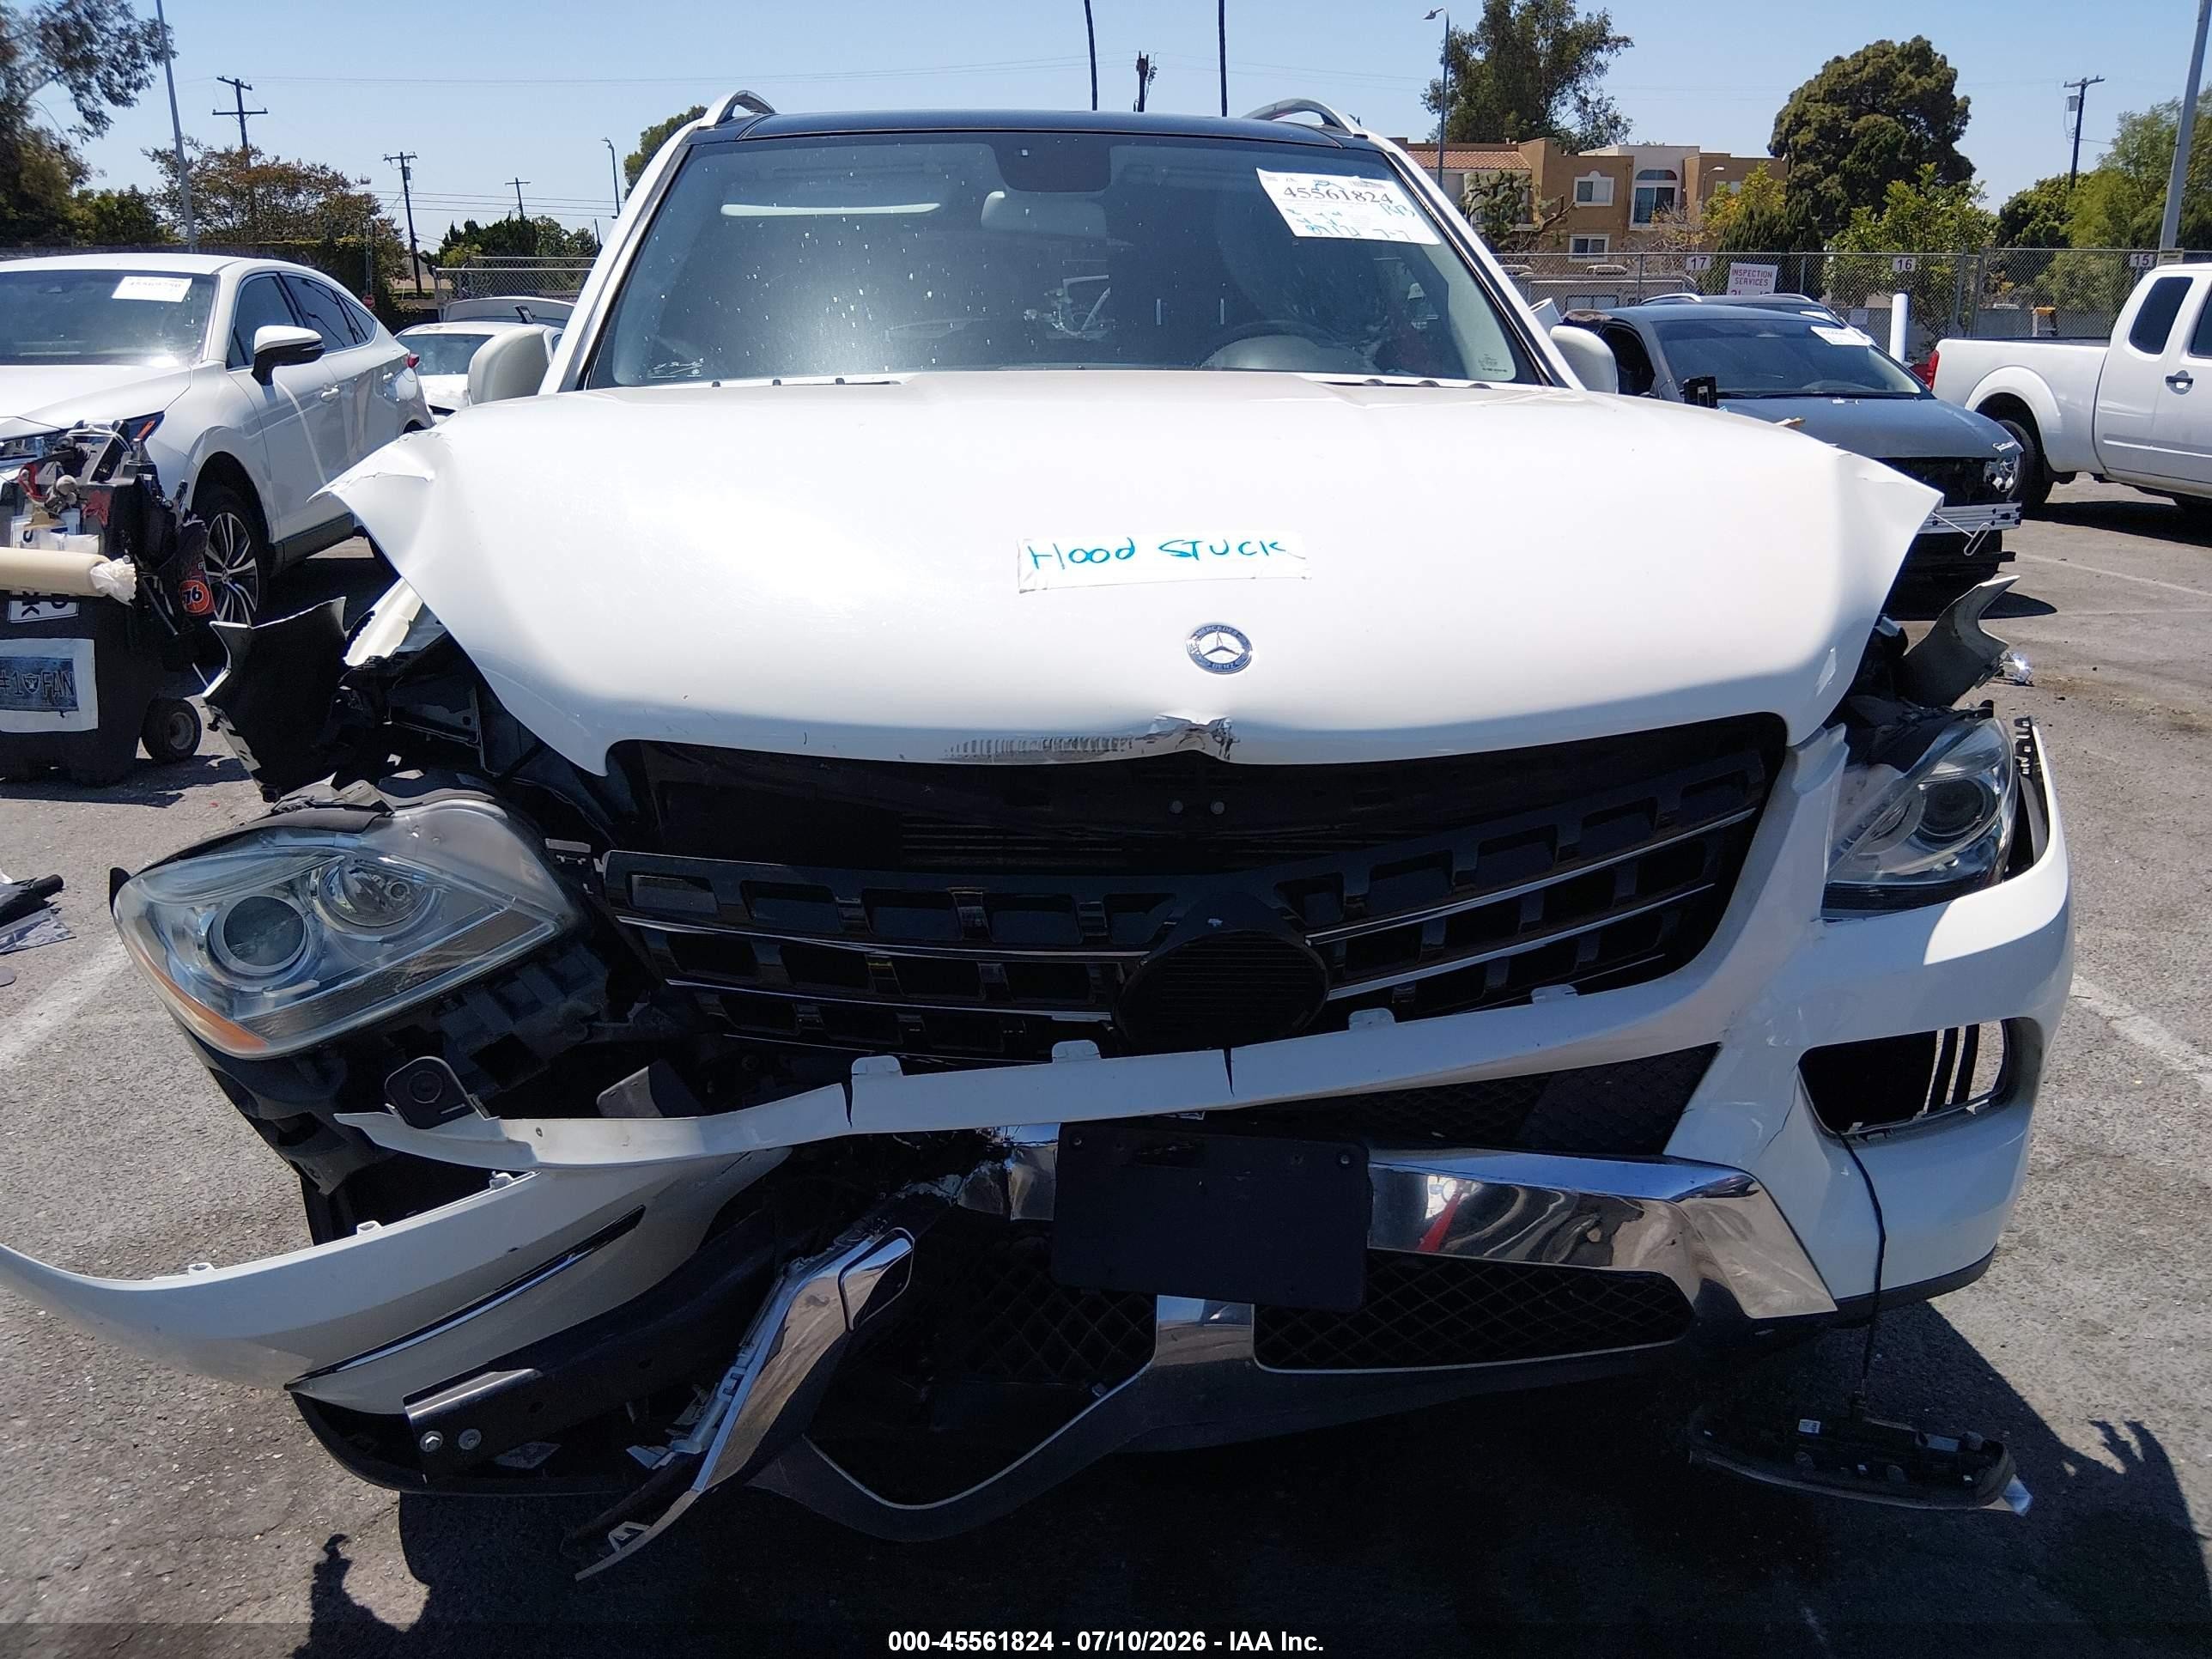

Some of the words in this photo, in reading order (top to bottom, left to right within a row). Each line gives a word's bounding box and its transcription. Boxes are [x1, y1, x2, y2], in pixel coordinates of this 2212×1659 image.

[1284, 186, 1393, 204] 45561824
[1691, 258, 1707, 270] 17
[1898, 258, 1912, 270] 16
[2135, 255, 2149, 266] 15
[1731, 269, 1772, 278] INSPECTION
[1735, 277, 1769, 287] SERVICES
[1028, 538, 1135, 569] Hood
[1159, 539, 1286, 560] STUCK
[182, 584, 204, 605] 76
[41, 670, 76, 697] FAN
